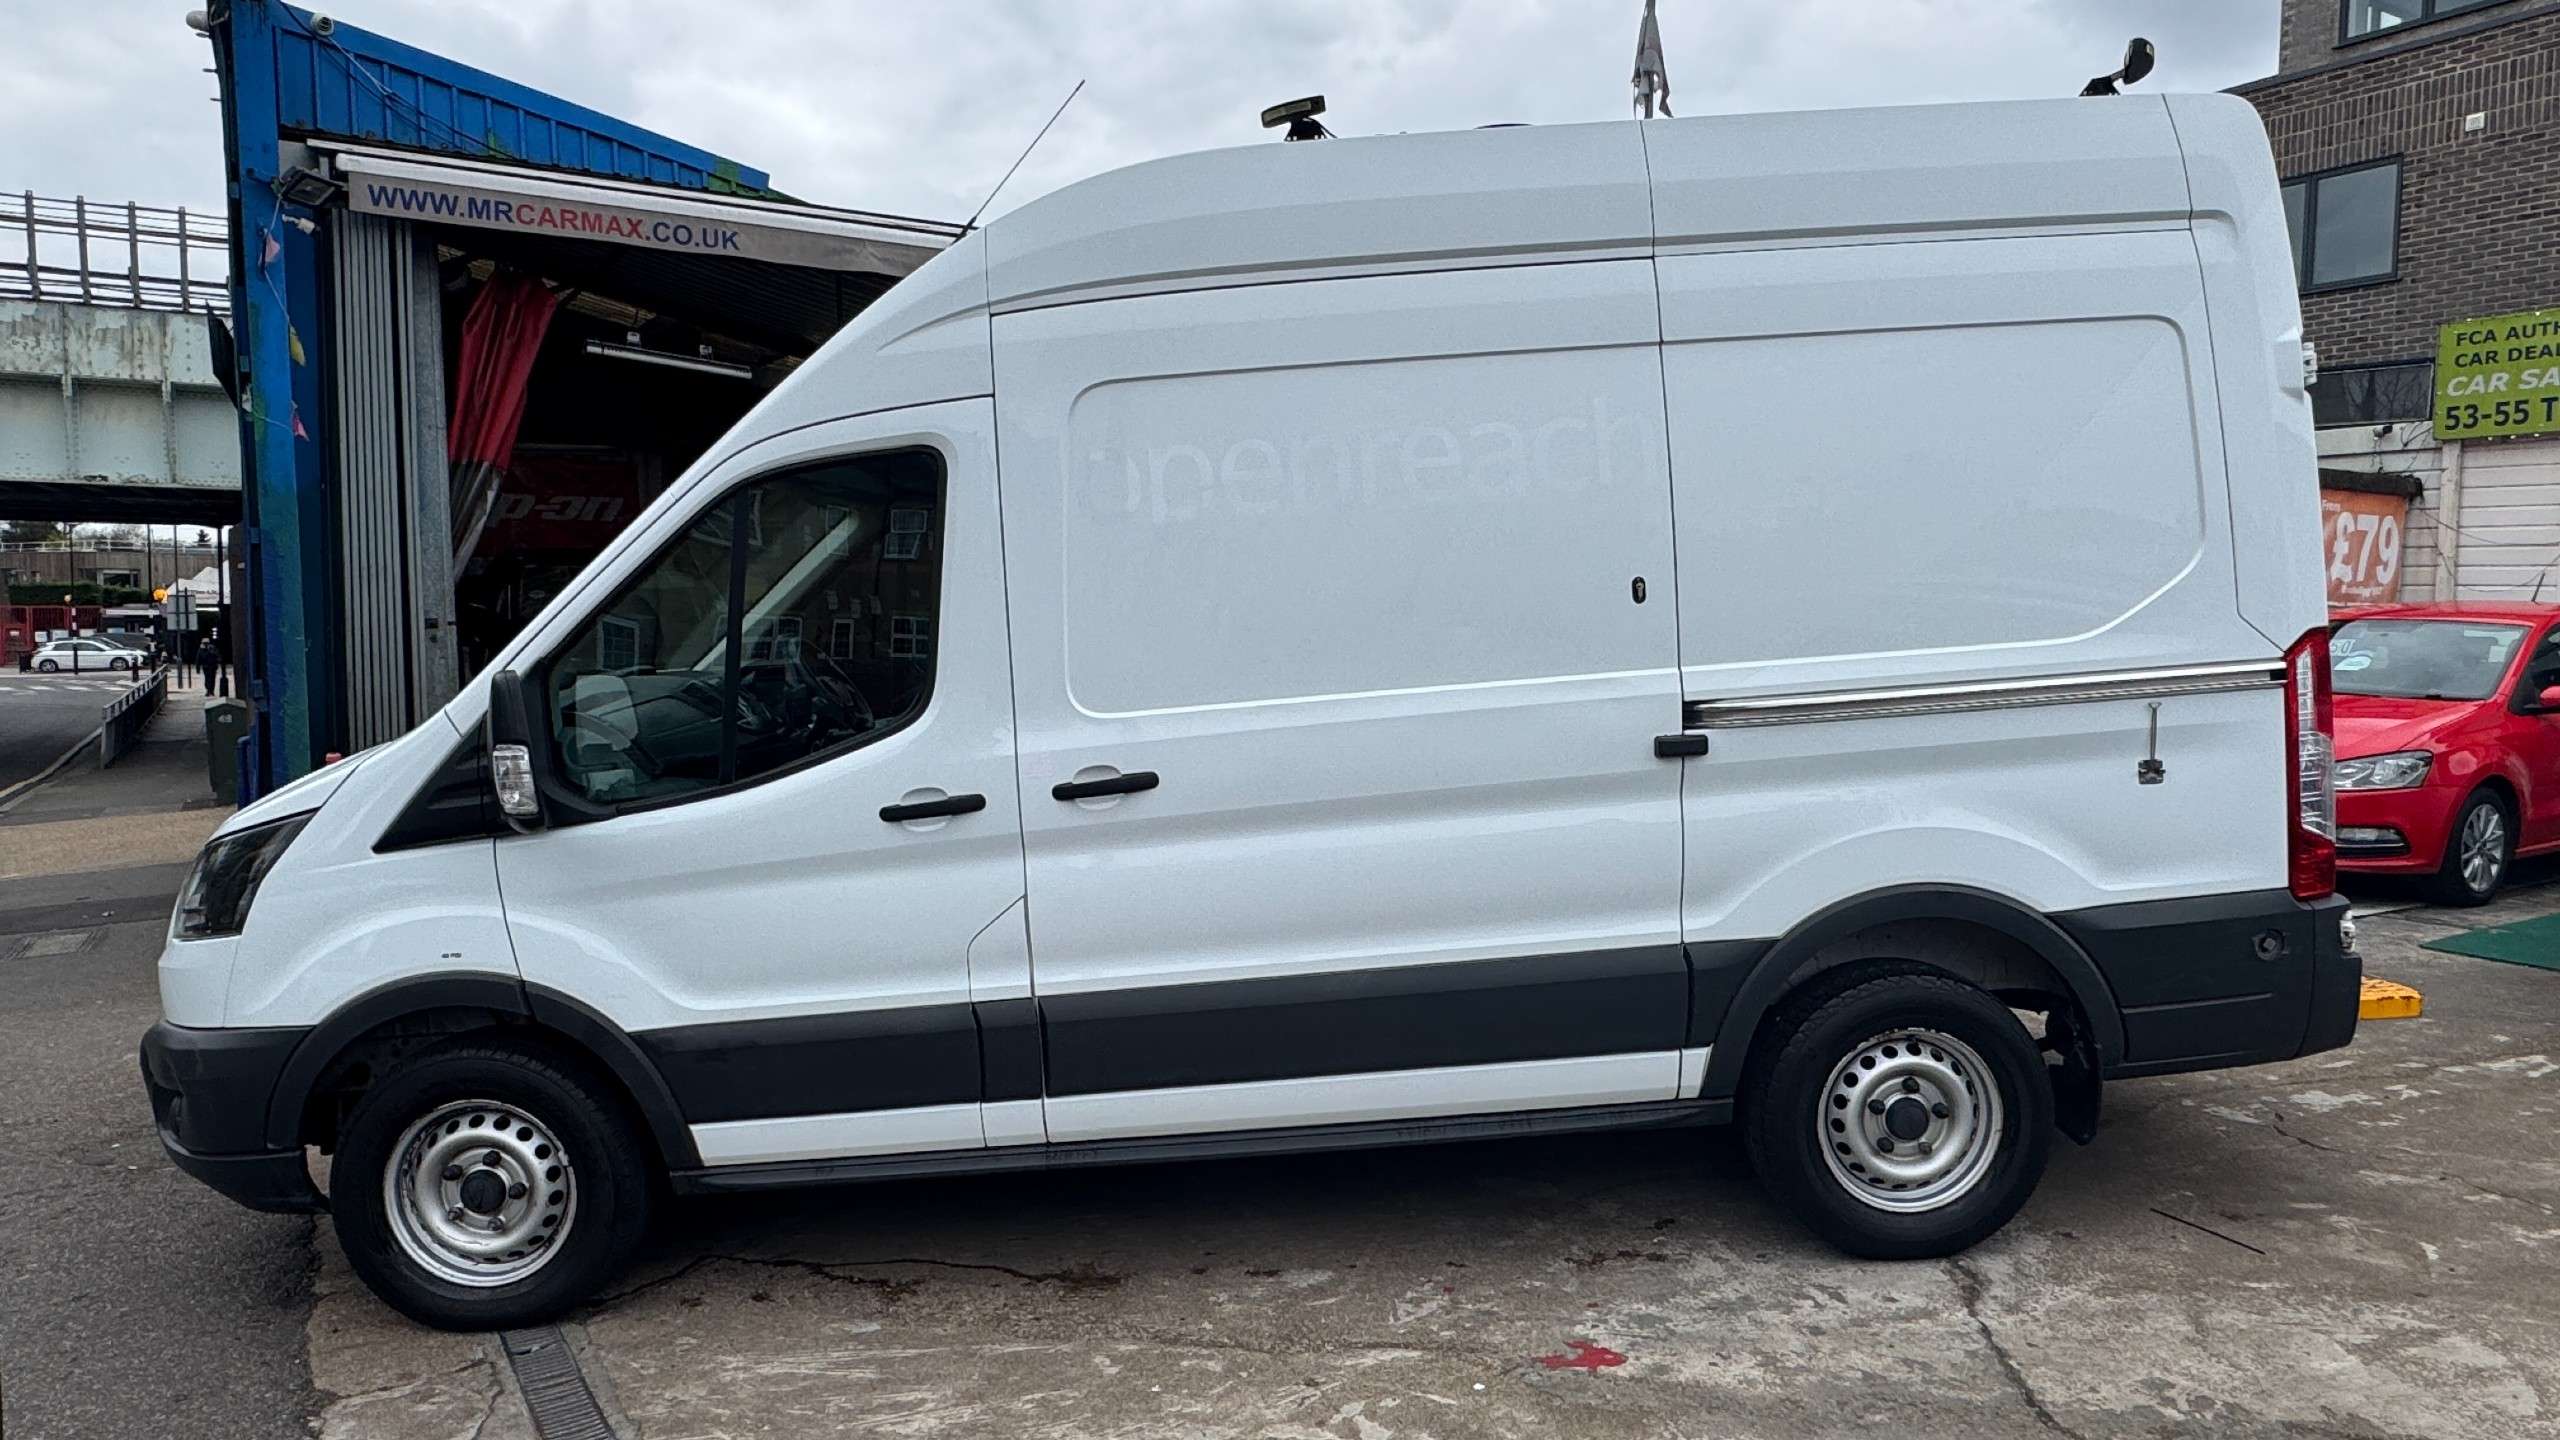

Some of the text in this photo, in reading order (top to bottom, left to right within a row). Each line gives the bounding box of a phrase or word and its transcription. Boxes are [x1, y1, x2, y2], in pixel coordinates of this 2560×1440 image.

[367, 183, 740, 250] WWW.MRCARMAX.CO.UK
[2456, 329, 2497, 346] FCA
[2454, 350, 2499, 368] CAR
[2447, 366, 2560, 396] CAR SA
[2444, 399, 2530, 430] 53-55
[2330, 511, 2400, 585] £79
